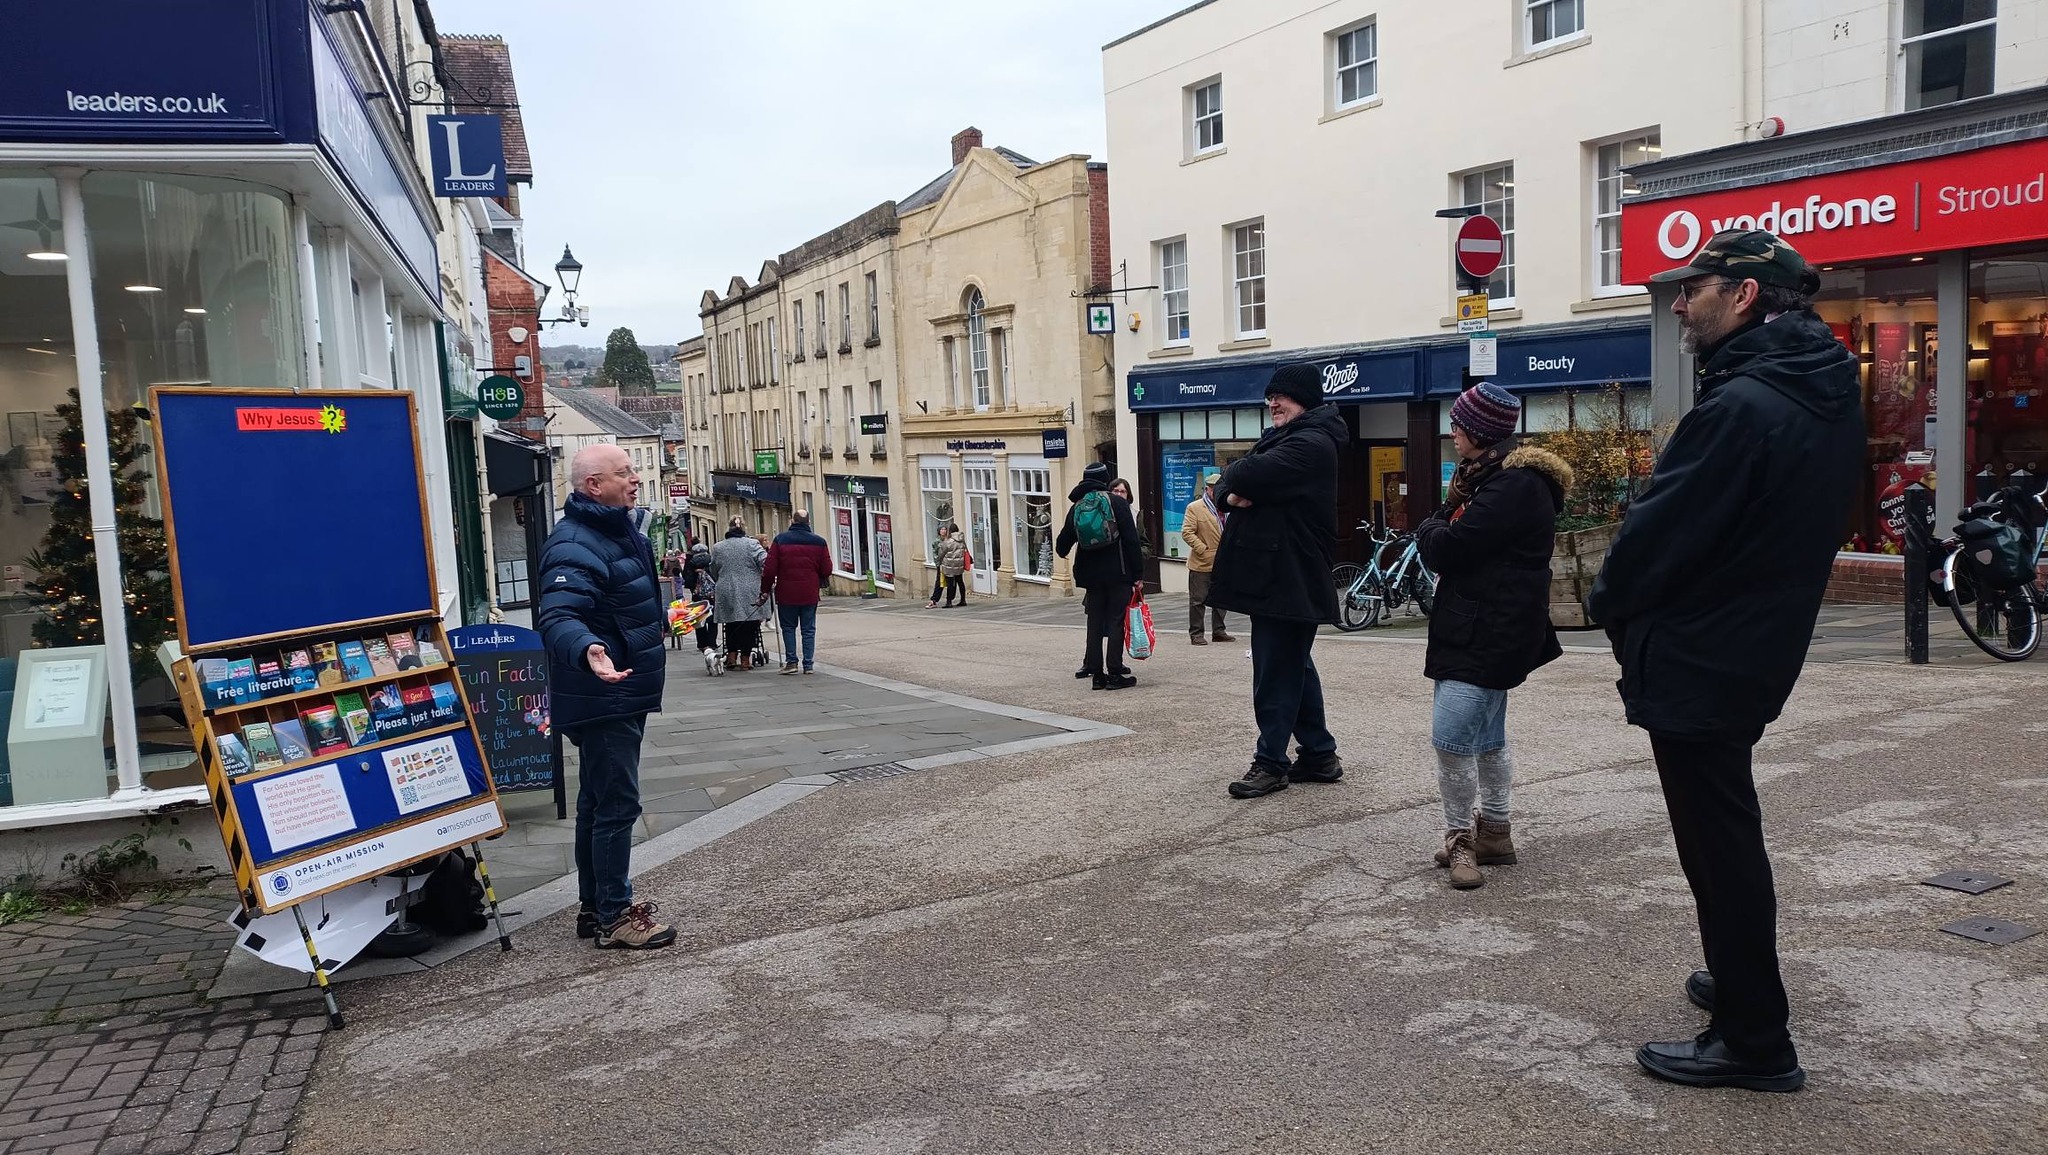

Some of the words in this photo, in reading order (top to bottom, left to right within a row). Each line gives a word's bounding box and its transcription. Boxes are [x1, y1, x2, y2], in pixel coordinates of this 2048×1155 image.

[66, 90, 228, 114] leaders.co.uk
[438, 121, 496, 180] L
[445, 182, 495, 190] LEADERS
[1710, 194, 1896, 236] vodafone
[1938, 172, 2044, 215] Stroud
[1528, 356, 1575, 373] Beauty
[1322, 362, 1359, 394] Boots
[483, 388, 517, 401] H&B
[1180, 383, 1217, 394] Pharmacy
[243, 413, 272, 428] Why
[276, 413, 314, 425] Jesus
[328, 410, 336, 426] ?
[947, 439, 964, 452] Insight
[1045, 438, 1065, 446] Insight
[1881, 494, 1905, 509] Conne
[471, 635, 515, 645] LEADERS
[498, 660, 545, 683] Facts
[216, 686, 244, 700] Free
[496, 686, 549, 712] Stroud
[411, 711, 428, 725] just
[430, 705, 453, 718] take!
[495, 730, 503, 740] to
[507, 728, 522, 738] live
[282, 746, 300, 754] Great
[224, 762, 245, 770] Worth
[492, 754, 551, 769] Lawnmower
[226, 767, 249, 776] Living?
[514, 772, 521, 781] in
[526, 767, 552, 780] Stroud
[275, 782, 288, 790] God
[297, 776, 314, 784] loved
[416, 780, 436, 792] Read
[436, 773, 460, 786] online!
[265, 793, 283, 801] world
[284, 789, 296, 797] that
[306, 783, 321, 792] gave
[279, 800, 292, 808] only
[293, 792, 320, 804] begotten
[284, 804, 309, 814] whoever
[310, 797, 335, 807] believes
[286, 812, 307, 822] should
[319, 804, 338, 815] perish
[302, 813, 336, 827] everlasting
[437, 812, 492, 836] oamission.com
[295, 856, 343, 877] OPEN-AIR
[345, 842, 385, 860] MISSION
[298, 876, 312, 886] Good
[312, 872, 326, 881] news
